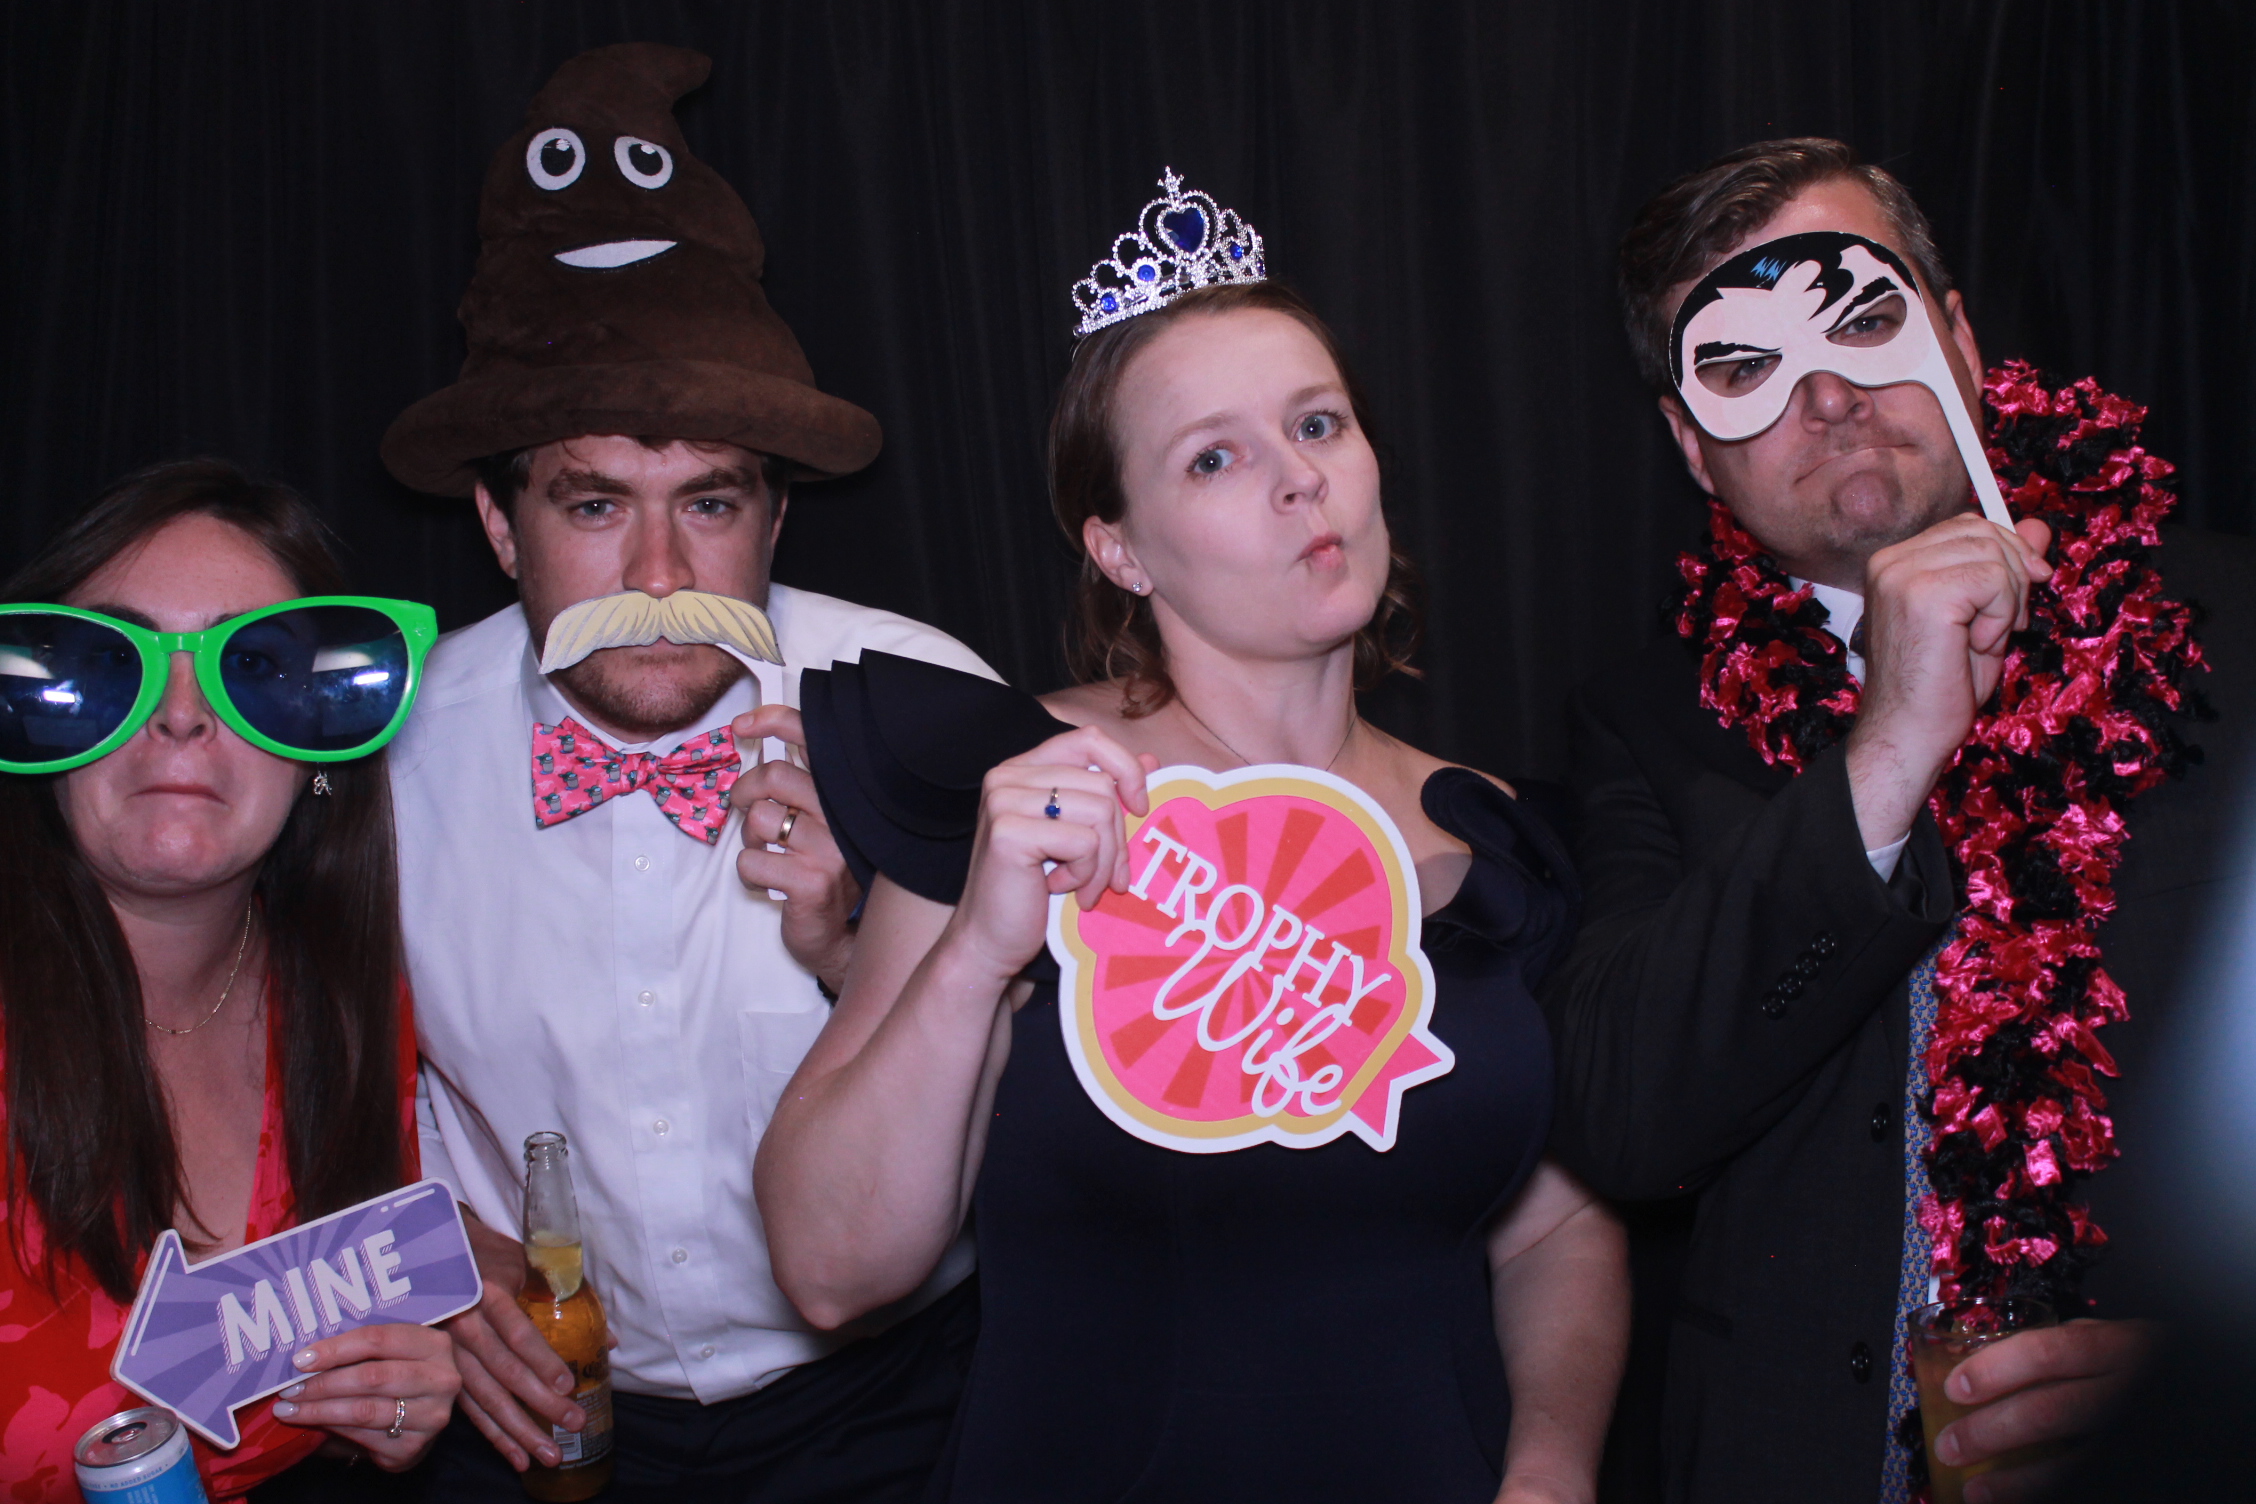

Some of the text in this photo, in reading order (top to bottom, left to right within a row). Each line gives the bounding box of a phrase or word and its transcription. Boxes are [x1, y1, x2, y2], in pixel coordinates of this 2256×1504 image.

[1128, 826, 1392, 1027] TROPHY
[1152, 919, 1347, 1118] Wife
[218, 1229, 412, 1373] MINE
[120, 1477, 142, 1487] ADDED
